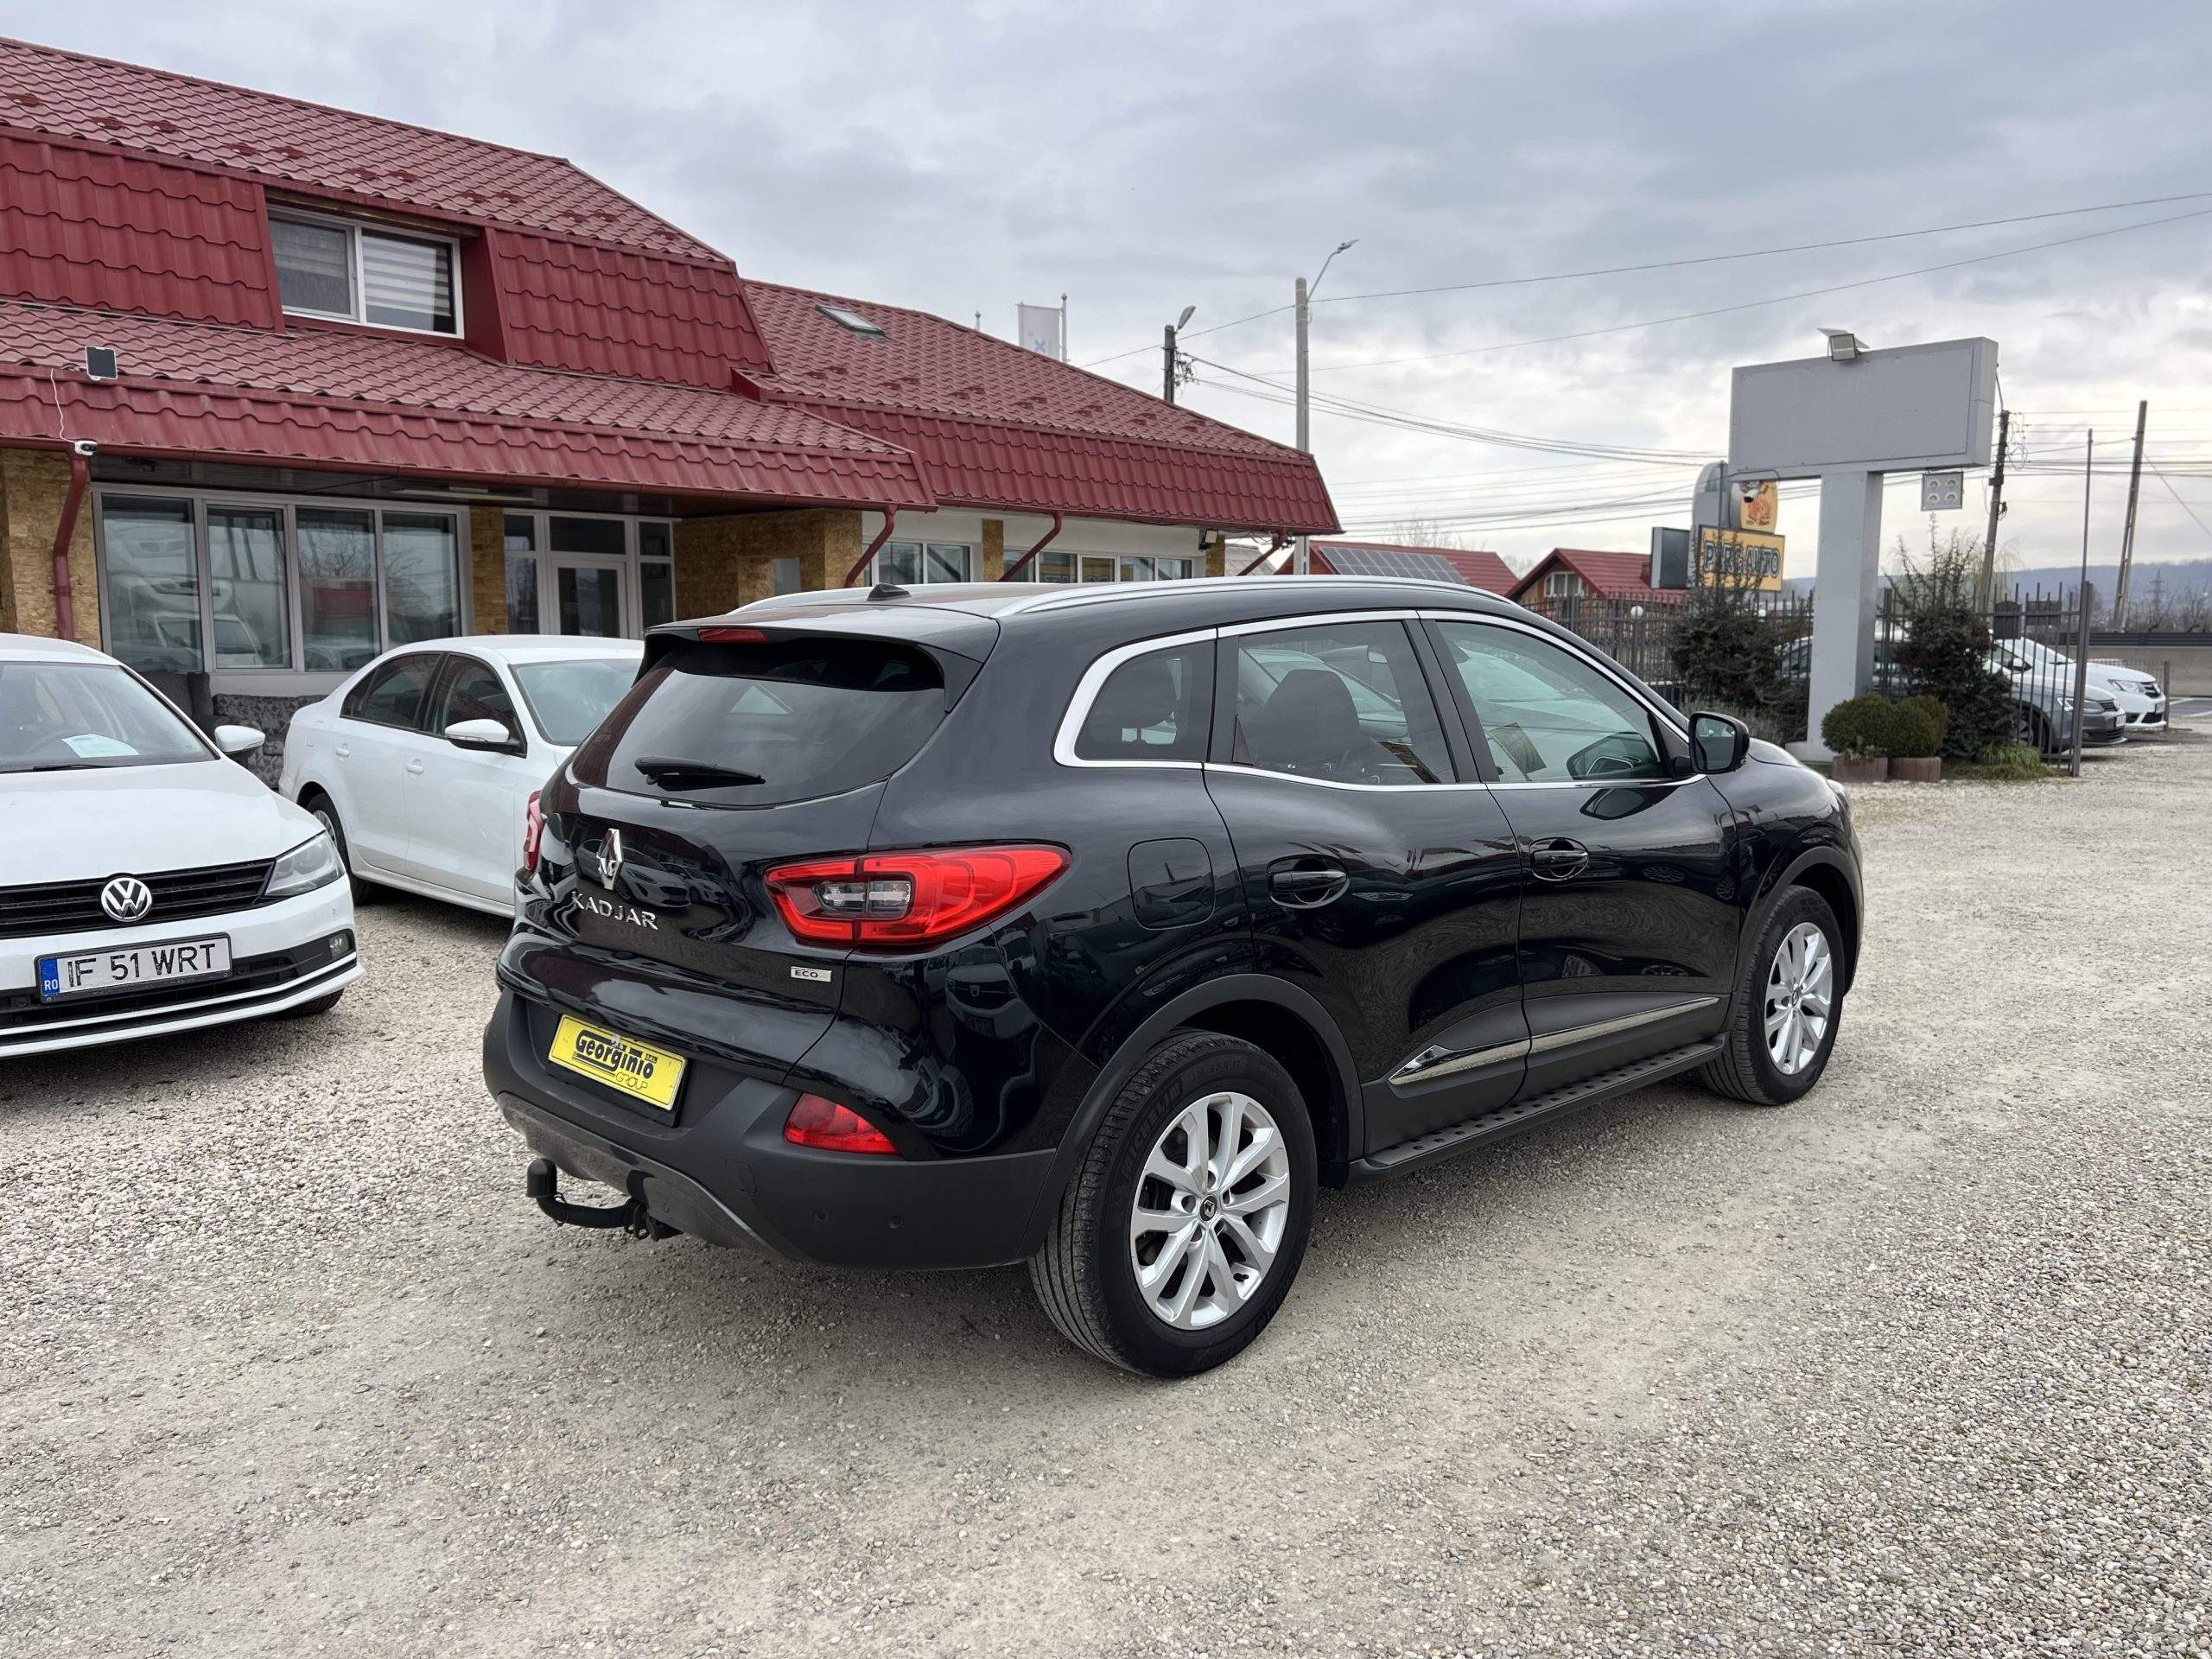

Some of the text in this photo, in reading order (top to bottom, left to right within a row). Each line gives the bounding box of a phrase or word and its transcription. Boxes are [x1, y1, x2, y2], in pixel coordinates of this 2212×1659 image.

[1704, 541, 1780, 578] PRC AUTO
[571, 891, 658, 930] KADJAR
[67, 957, 96, 988] IF
[110, 952, 139, 981] 51
[151, 943, 216, 976] WRT
[44, 979, 59, 991] RO
[575, 1030, 654, 1079] Georginio
[615, 1071, 649, 1091] GROUP
